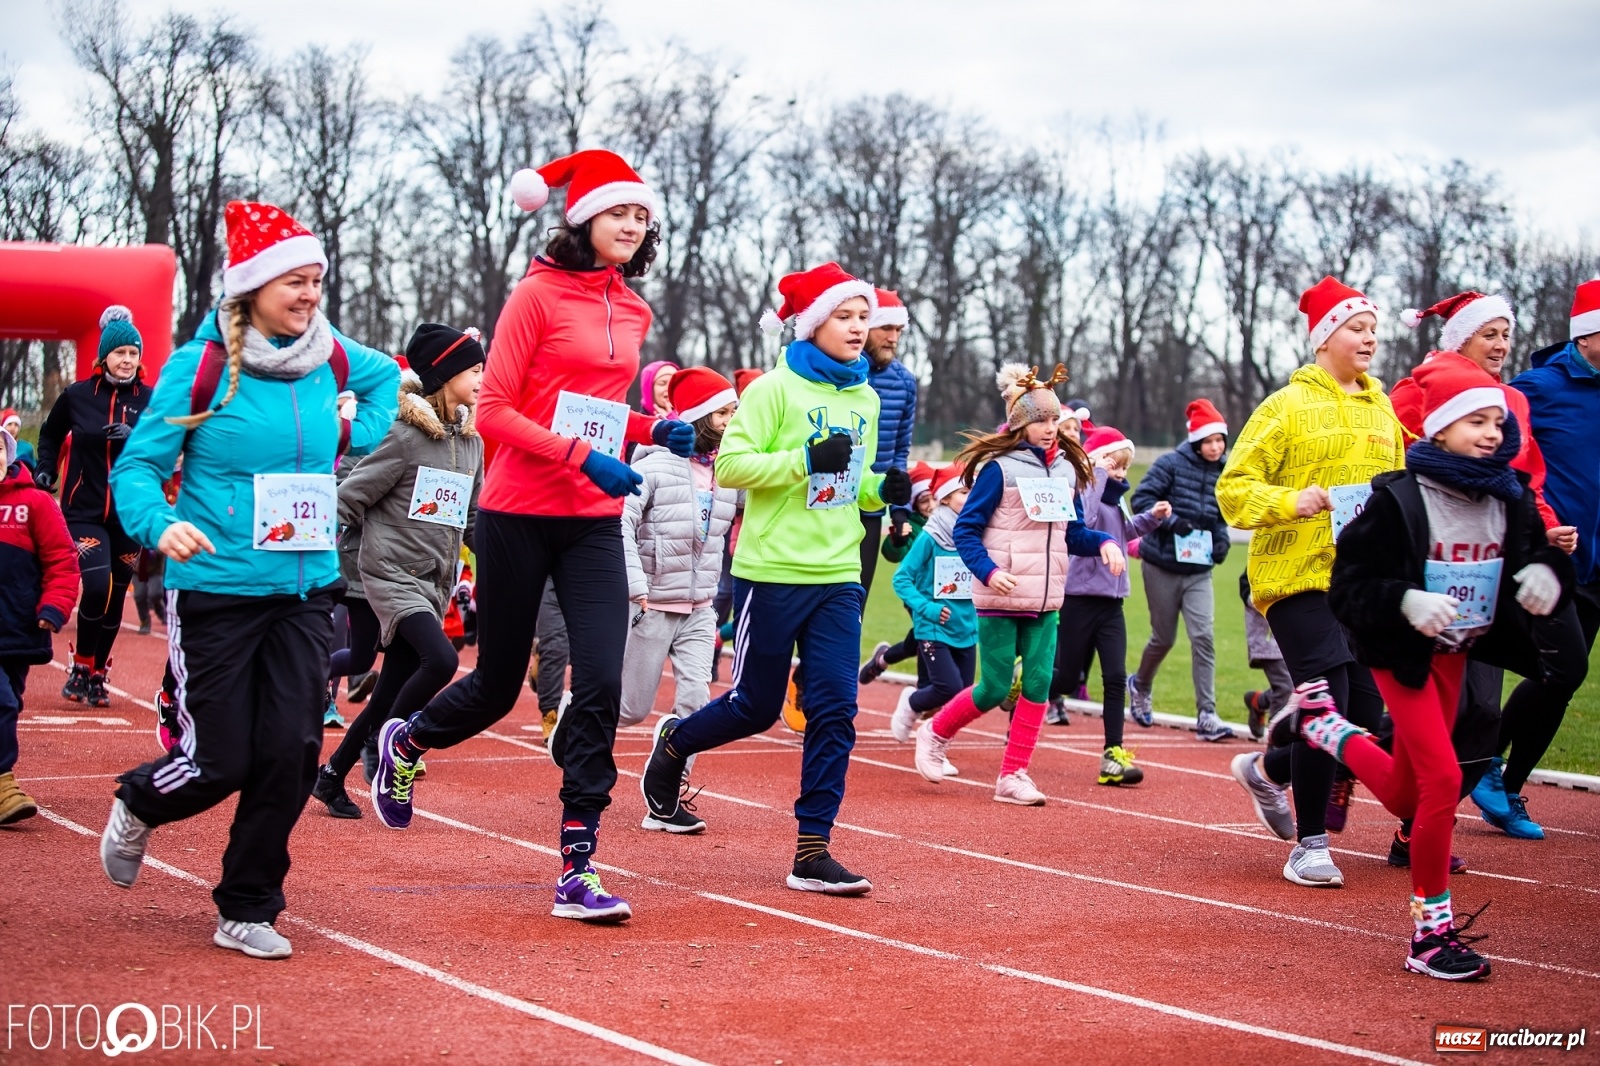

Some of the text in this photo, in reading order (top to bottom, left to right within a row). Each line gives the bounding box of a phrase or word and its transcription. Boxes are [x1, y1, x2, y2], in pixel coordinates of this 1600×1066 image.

[583, 420, 605, 440] 151
[435, 487, 457, 503] 054
[1034, 492, 1055, 503] 052
[0, 504, 29, 523] 78
[292, 501, 317, 519] 121
[954, 571, 973, 582] 207
[1447, 585, 1476, 602] 091
